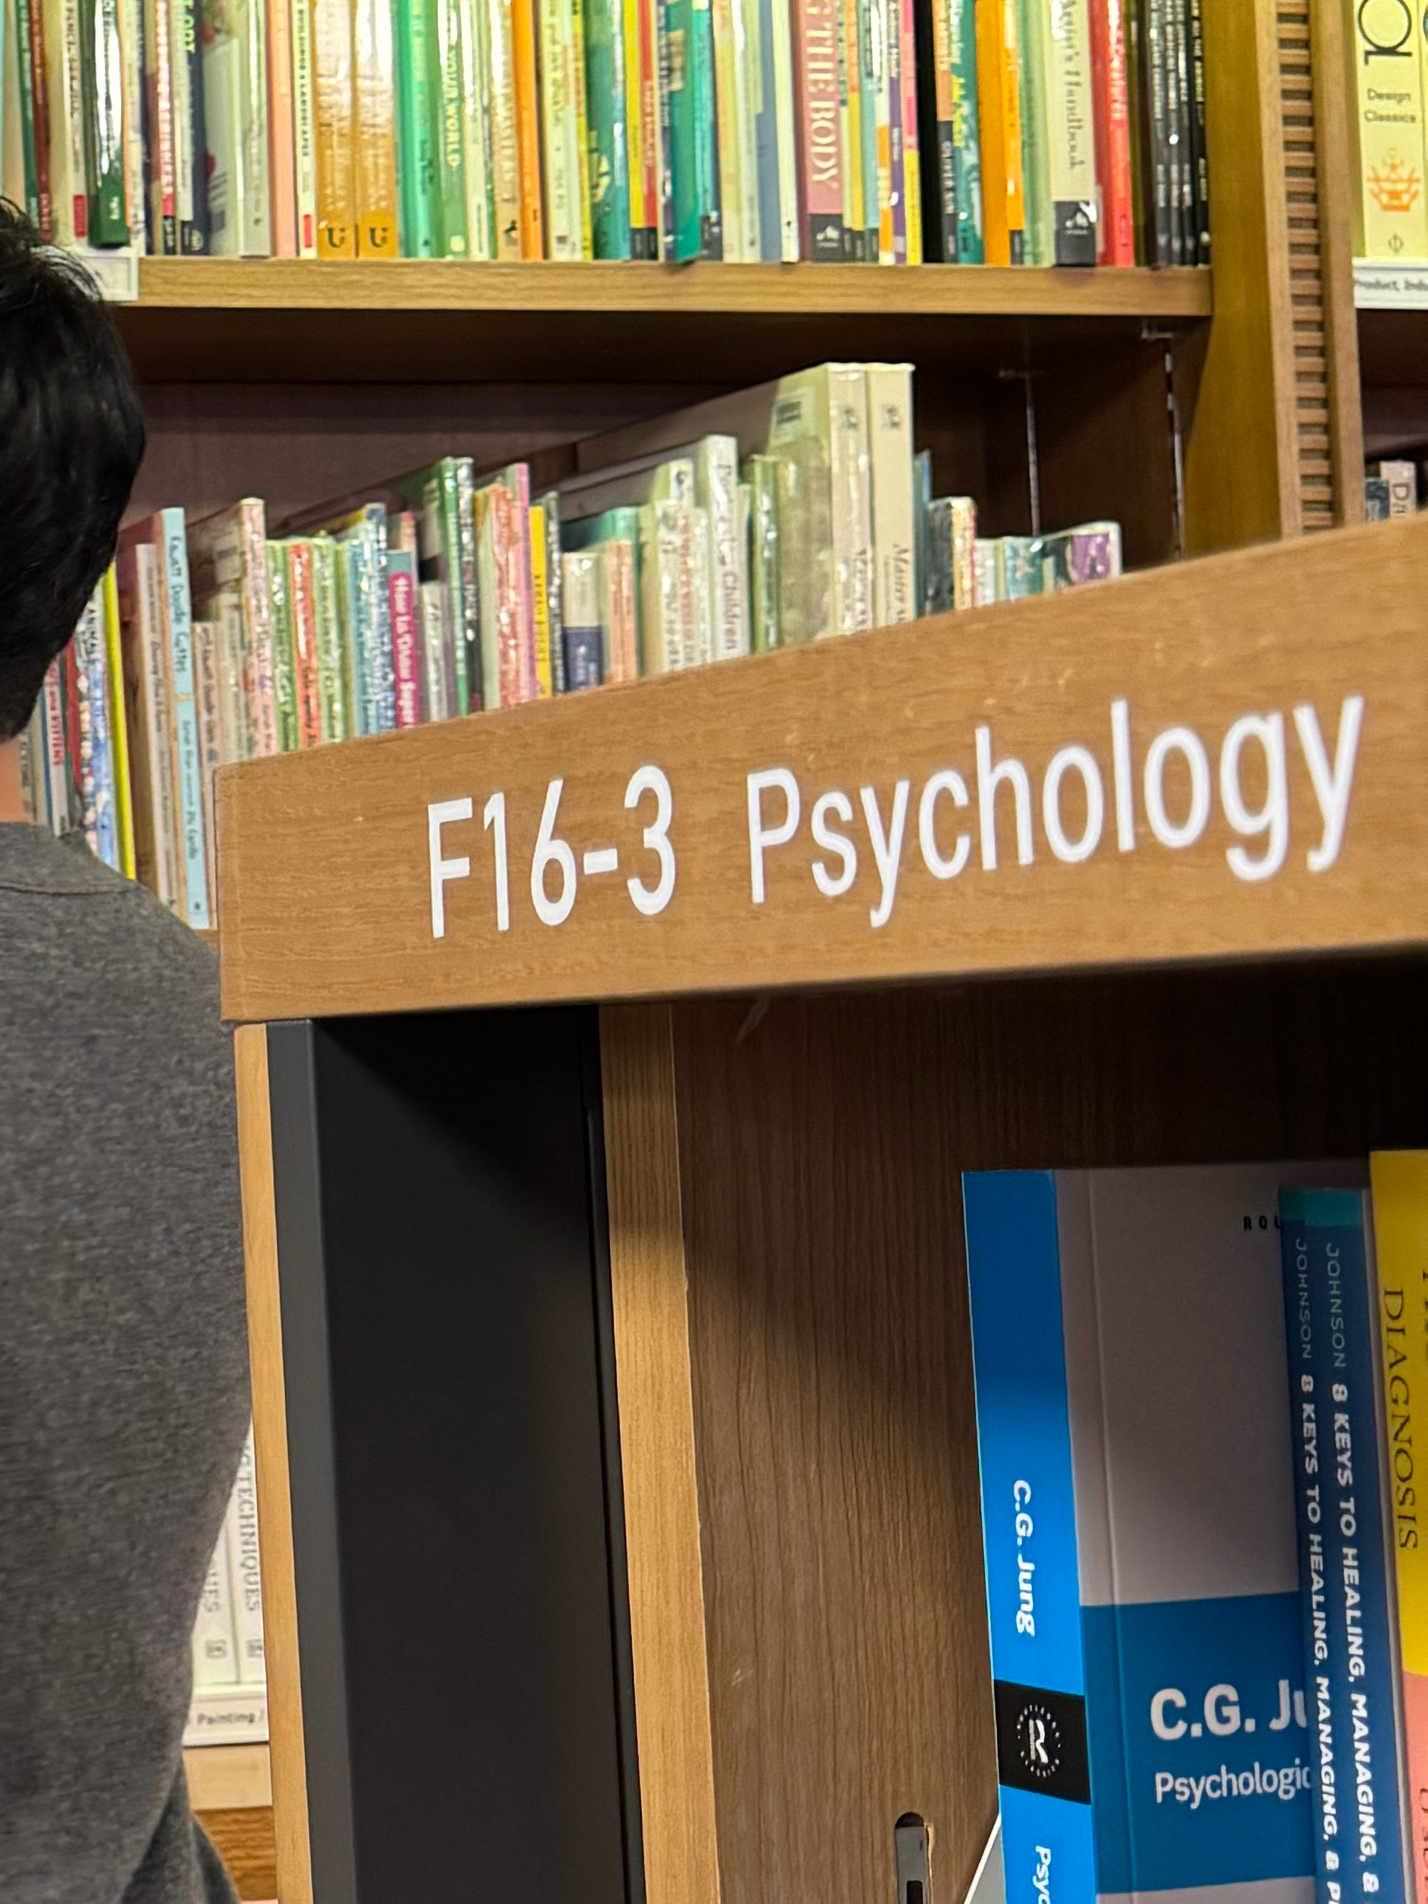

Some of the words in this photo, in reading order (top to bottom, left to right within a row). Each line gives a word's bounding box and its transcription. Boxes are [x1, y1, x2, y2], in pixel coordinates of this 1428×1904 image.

[804, 16, 834, 95] THE
[1364, 109, 1417, 125] Classics
[1367, 88, 1412, 104] Design
[808, 99, 840, 190] BODY
[427, 762, 677, 940] F16-3
[746, 695, 1366, 929] Psychology
[1327, 1242, 1347, 1369] JOHNSON
[1330, 1383, 1348, 1402] 8
[1383, 1288, 1418, 1552] DIAGNOSIS
[1332, 1412, 1354, 1488] KEYS
[1013, 1480, 1034, 1547] C.G.
[1338, 1495, 1356, 1537] TO
[1016, 1552, 1036, 1637] Jung
[1150, 1684, 1256, 1740] C.G.
[1362, 1871, 1379, 1892] &
